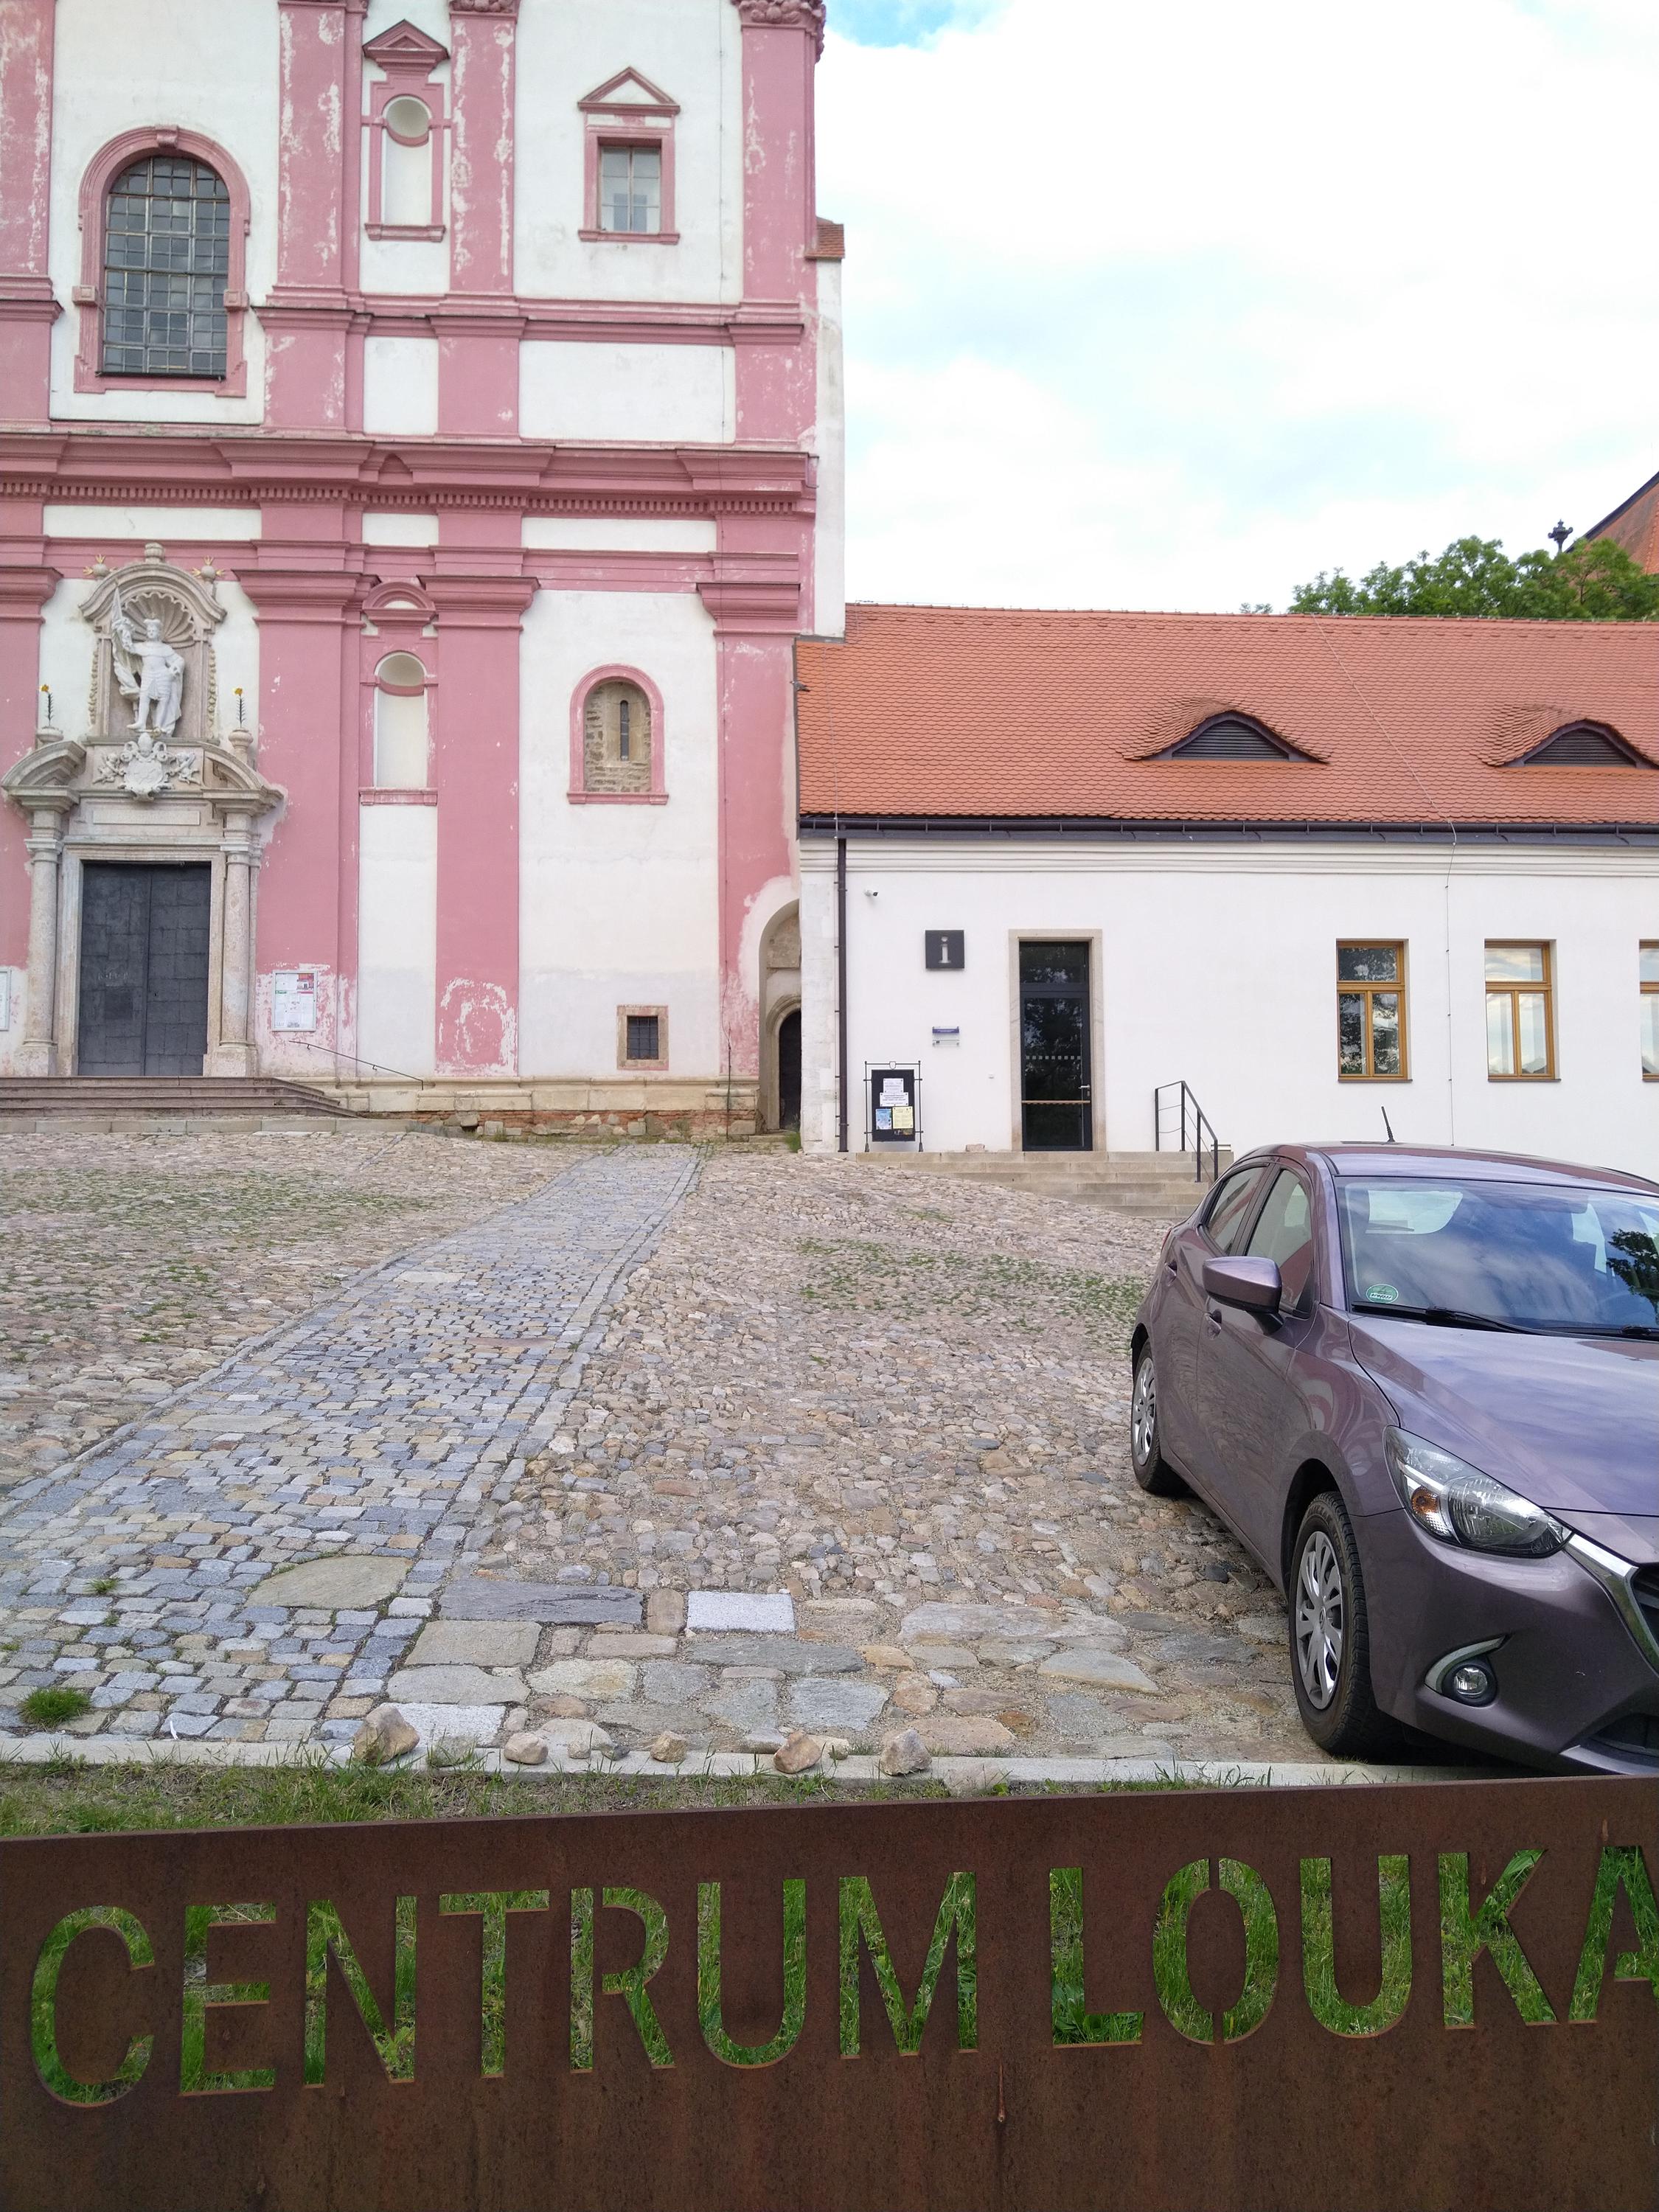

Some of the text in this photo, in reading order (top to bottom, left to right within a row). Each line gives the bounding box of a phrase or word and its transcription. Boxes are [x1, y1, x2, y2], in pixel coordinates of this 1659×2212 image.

[939, 936, 951, 964] i
[29, 1846, 1659, 2109] CENTRUM LOUKA
